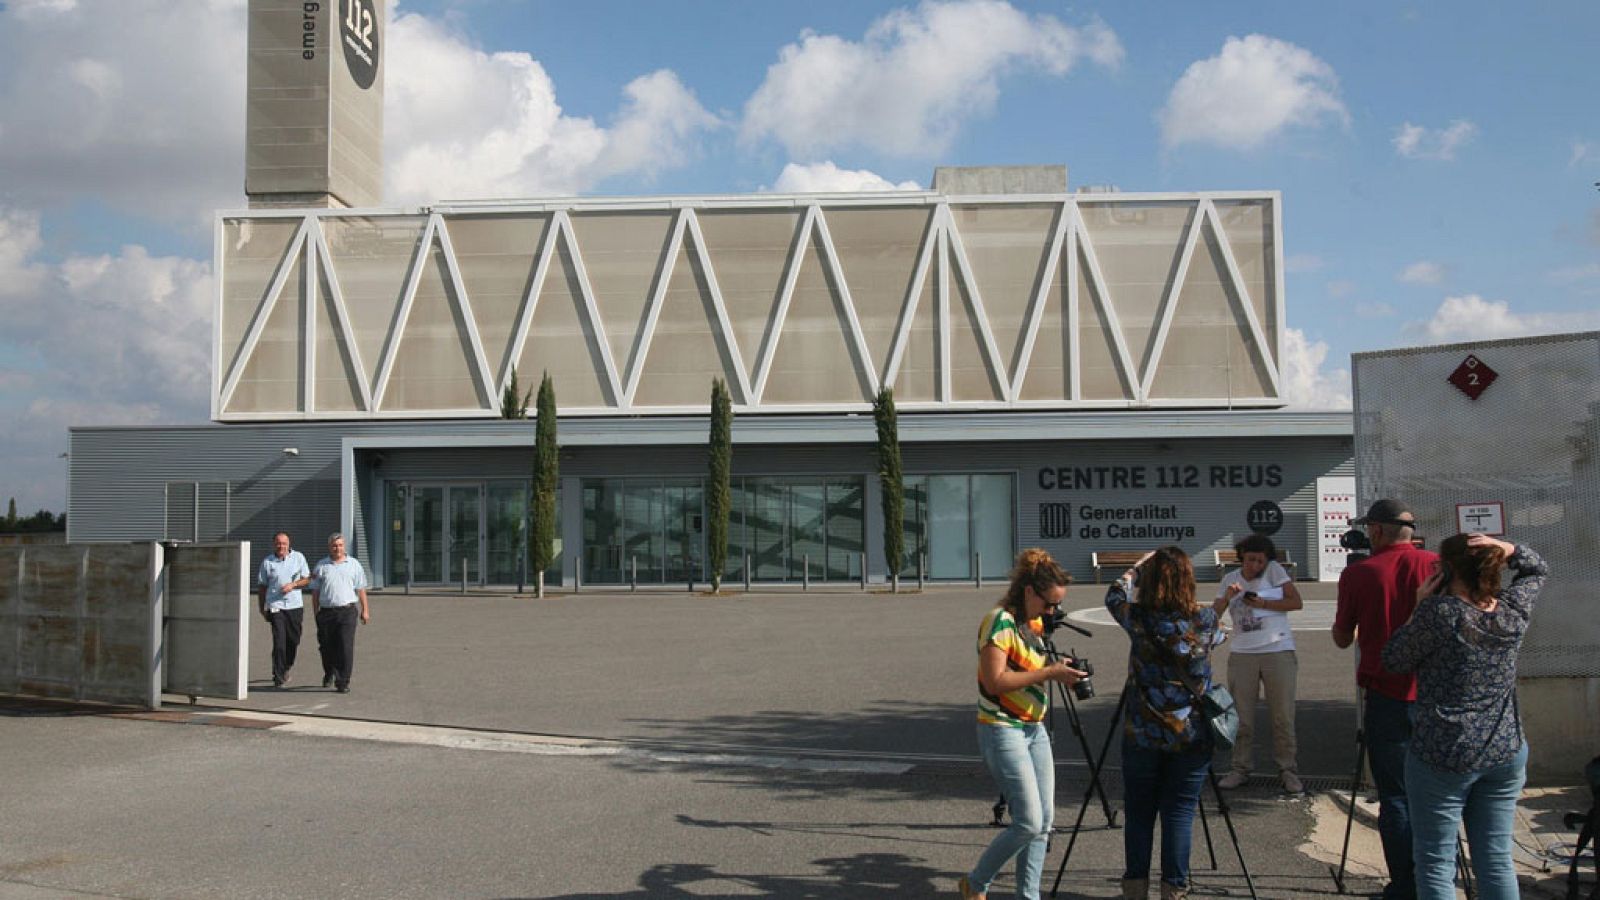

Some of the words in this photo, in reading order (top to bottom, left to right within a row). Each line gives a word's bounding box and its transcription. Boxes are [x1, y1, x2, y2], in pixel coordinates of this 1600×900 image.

[302, 2, 319, 60] emerg
[346, 0, 373, 51] 112
[1467, 373, 1480, 385] 2
[1038, 466, 1146, 490] CENTRE
[1155, 465, 1199, 488] 112
[1209, 464, 1283, 488] REUS
[1080, 504, 1176, 520] Generalitat
[1252, 509, 1279, 523] 112
[1080, 524, 1101, 539] de
[1107, 523, 1195, 541] Catalunya
